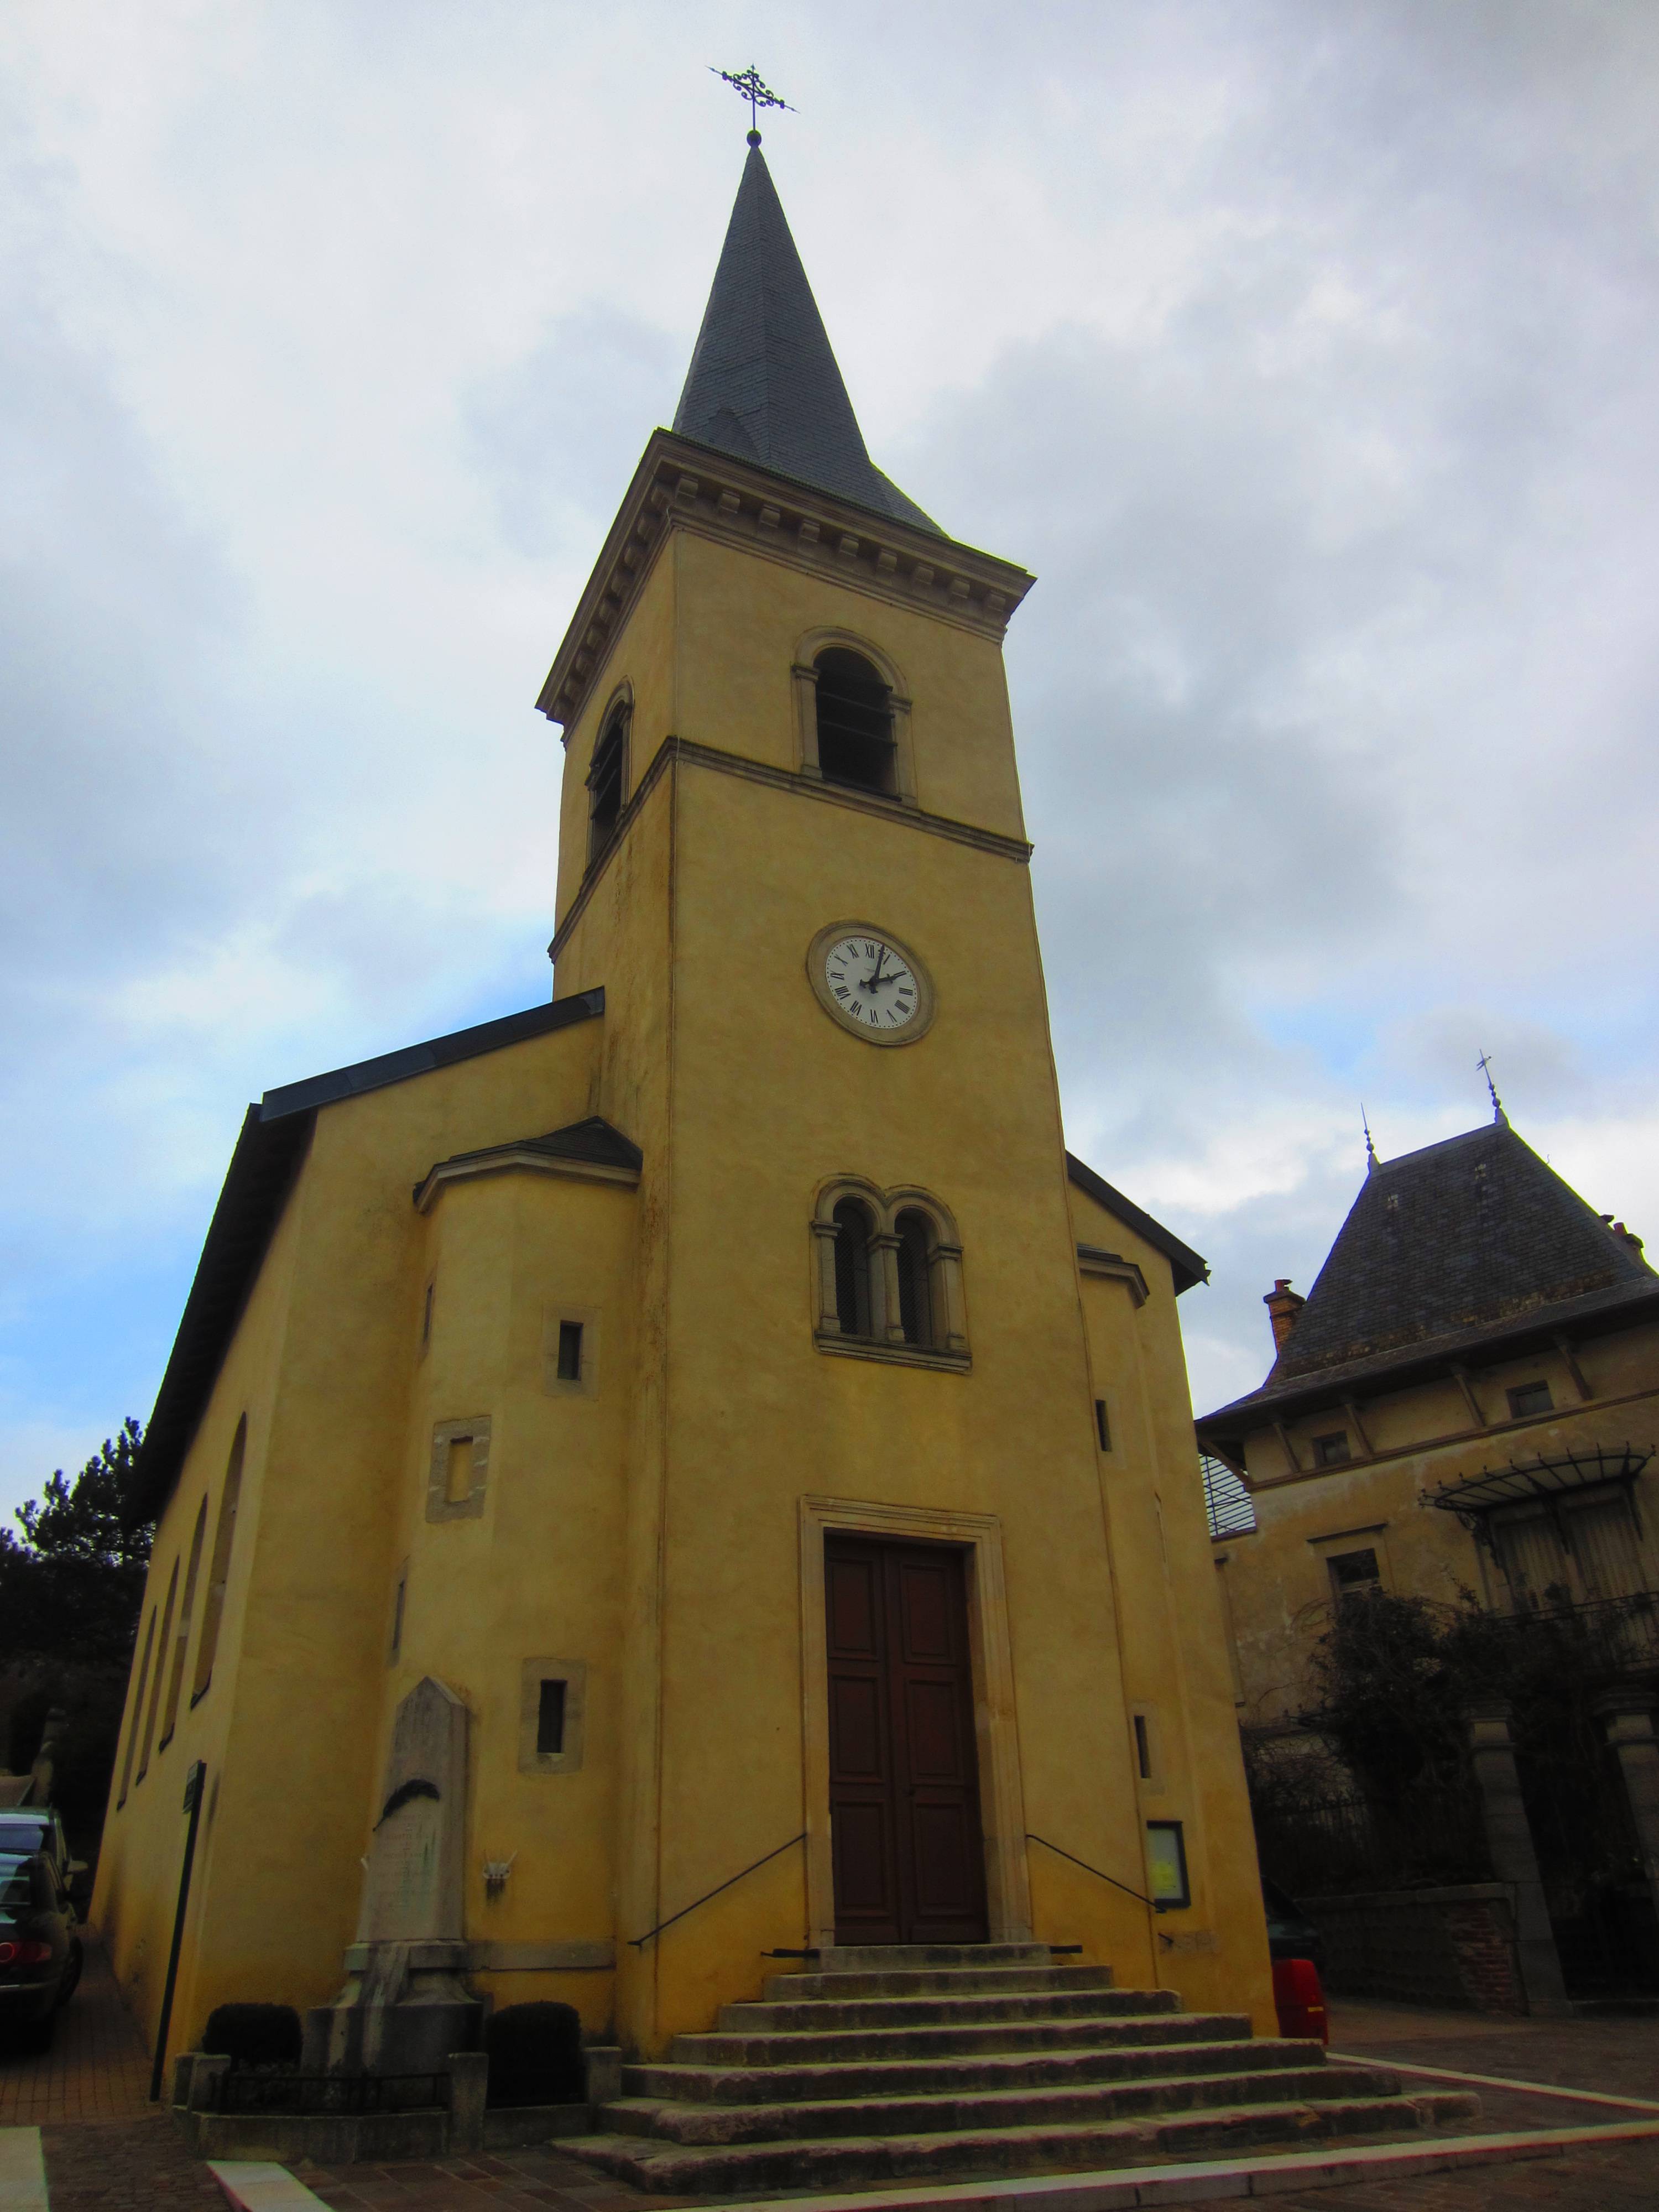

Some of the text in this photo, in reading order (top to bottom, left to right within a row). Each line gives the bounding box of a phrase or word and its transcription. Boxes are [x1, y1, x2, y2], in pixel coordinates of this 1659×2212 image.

[847, 944, 859, 959] XI
[865, 943, 874, 959] XII
[834, 954, 848, 967] X
[883, 954, 890, 965] I
[831, 971, 844, 980] IX
[834, 986, 851, 1000] VIII
[899, 987, 913, 996] III
[850, 1000, 862, 1016] VII
[870, 1009, 878, 1023] VI
[887, 1010, 897, 1023] V
